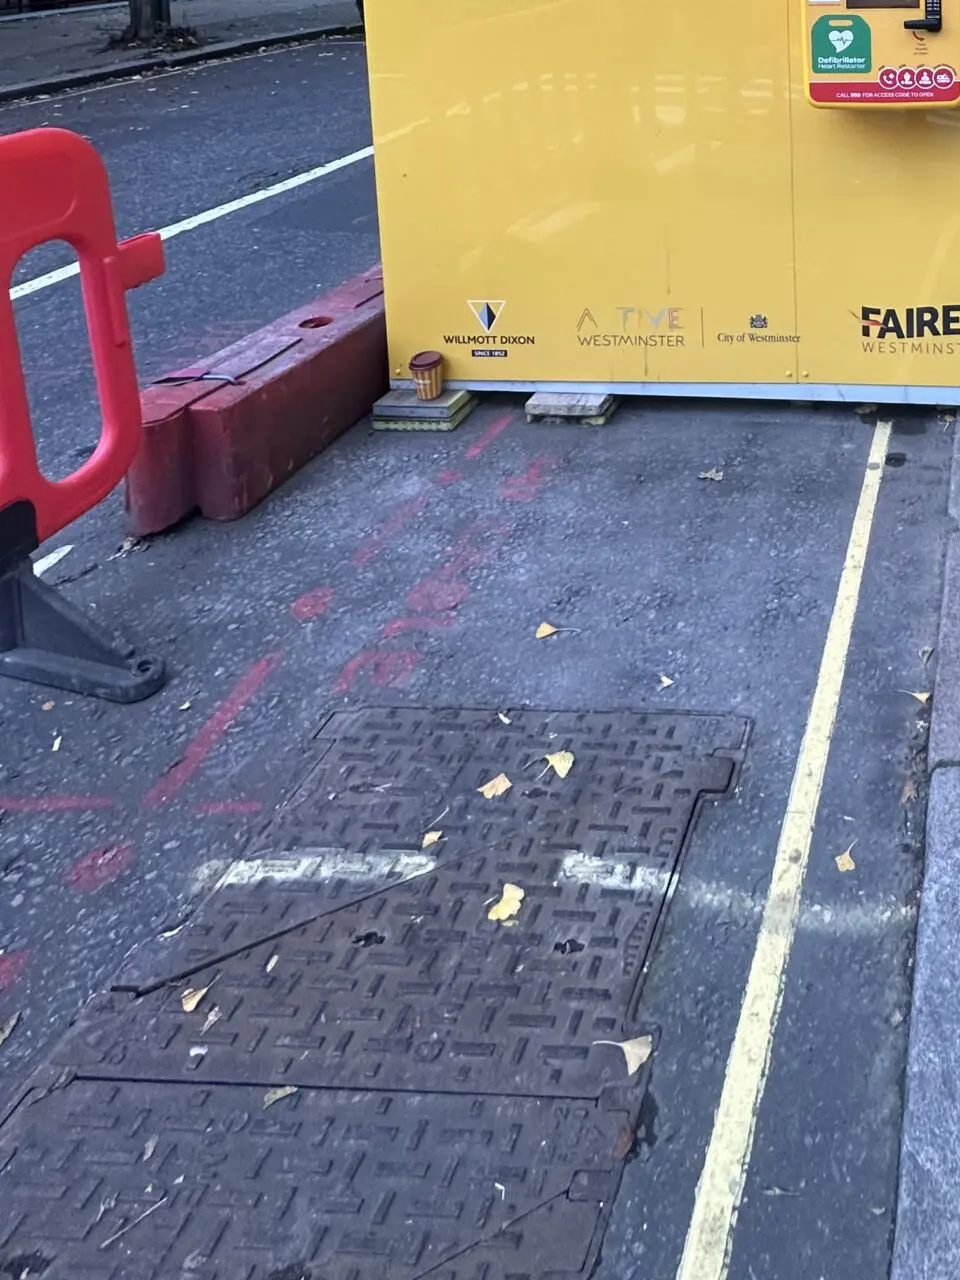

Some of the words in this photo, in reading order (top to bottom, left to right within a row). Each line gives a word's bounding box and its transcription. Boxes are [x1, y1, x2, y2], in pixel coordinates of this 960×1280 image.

[817, 56, 866, 64] Defibrillator
[443, 335, 497, 345] WILLMOTT
[500, 335, 535, 345] DIXON
[577, 334, 685, 347] WESTMINSTER
[717, 332, 734, 344] City
[735, 331, 747, 342] of
[748, 332, 801, 343] Westminster
